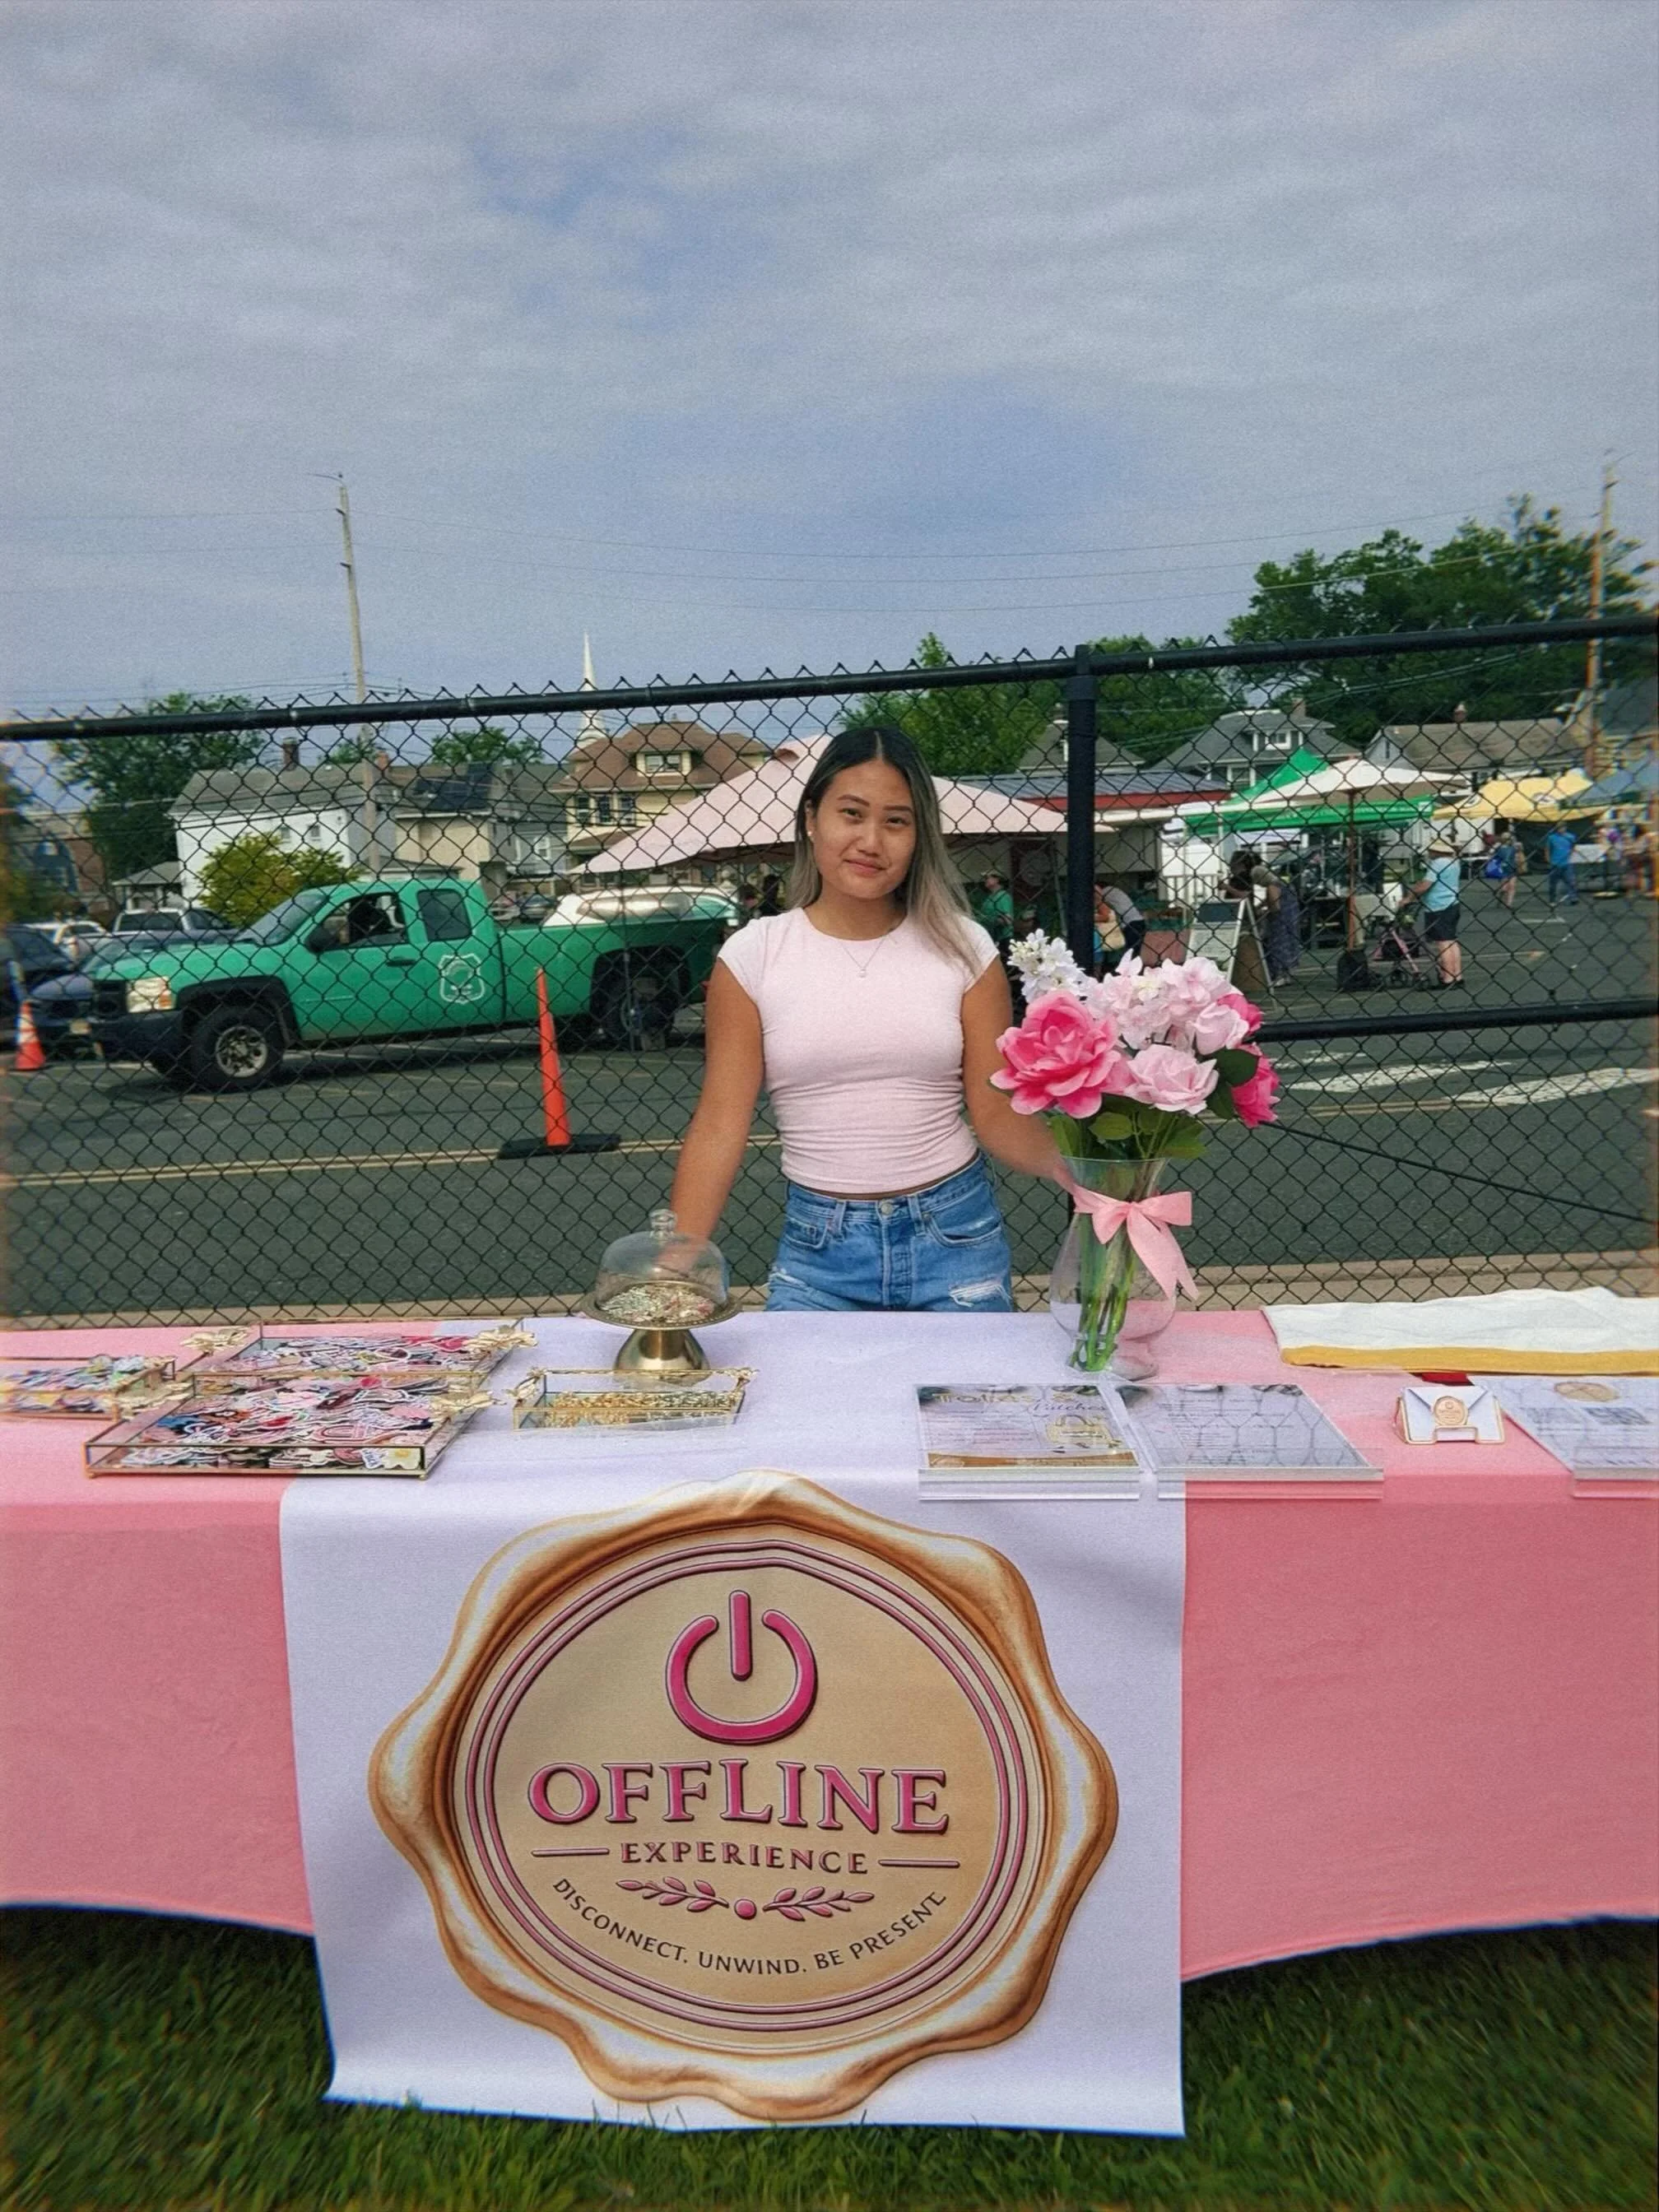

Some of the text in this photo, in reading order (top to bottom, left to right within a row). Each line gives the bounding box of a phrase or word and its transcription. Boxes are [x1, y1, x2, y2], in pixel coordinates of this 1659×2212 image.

[527, 1758, 949, 1833] OFFLINE
[620, 1841, 868, 1874] EXPERIENCE
[553, 1878, 688, 1963] DISCONNECT.
[699, 1953, 806, 1974] UNWIND.
[816, 1949, 845, 1970] BE
